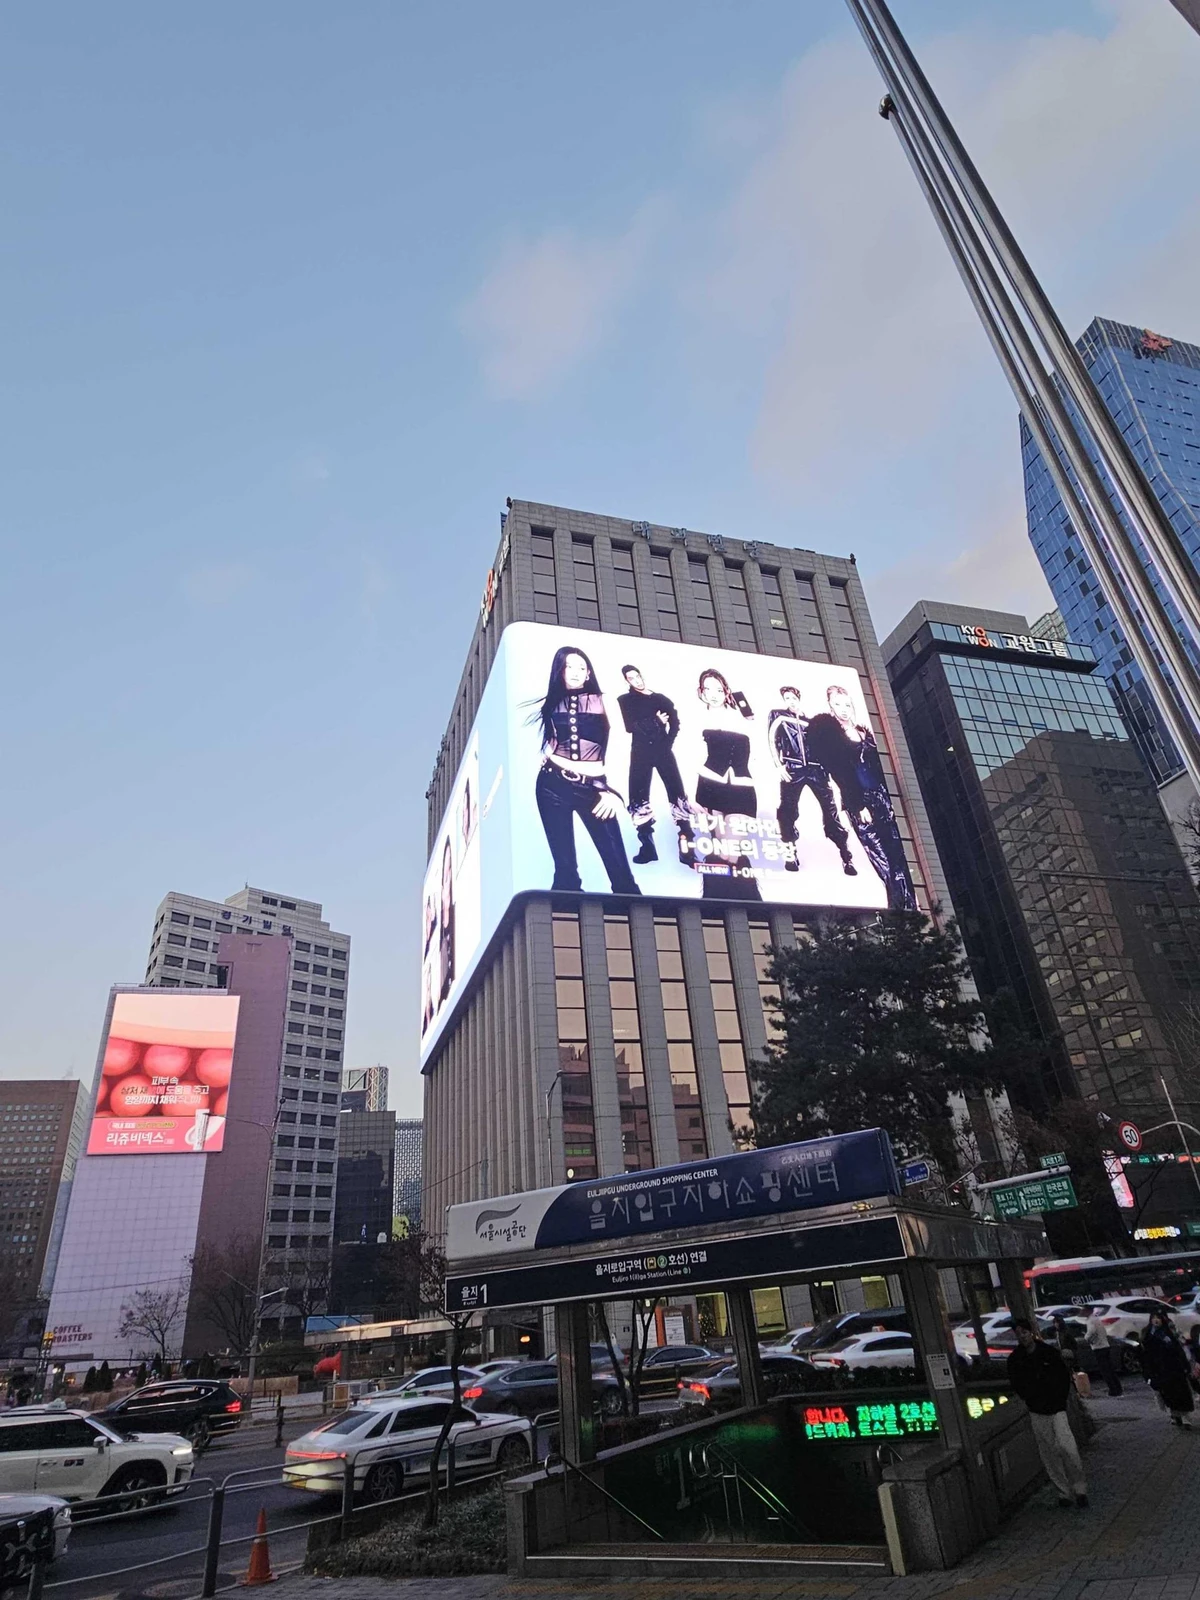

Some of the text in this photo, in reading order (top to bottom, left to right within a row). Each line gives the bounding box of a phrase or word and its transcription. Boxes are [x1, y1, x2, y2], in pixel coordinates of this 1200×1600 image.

[961, 625, 986, 637] KYO
[967, 635, 998, 648] WON
[1001, 633, 1068, 658] 교원그룹
[689, 812, 727, 835] 내가
[152, 1076, 179, 1085] 피부 속
[106, 1132, 164, 1146] 리쥬비넥스
[1124, 1128, 1138, 1144] 50
[616, 1178, 661, 1194] UNDERGROUND
[662, 1173, 693, 1187] SHOPPING
[693, 1168, 719, 1180] CENTER
[480, 1220, 527, 1242] 서울시설공단
[595, 1259, 642, 1276] 을지로입구역
[689, 1250, 708, 1264] 연결
[646, 1268, 667, 1279] Station
[461, 1284, 488, 1304] 을지 1
[53, 1324, 83, 1334] COFFEE
[52, 1333, 93, 1344] ROASTERS
[856, 1403, 898, 1421] 지하철
